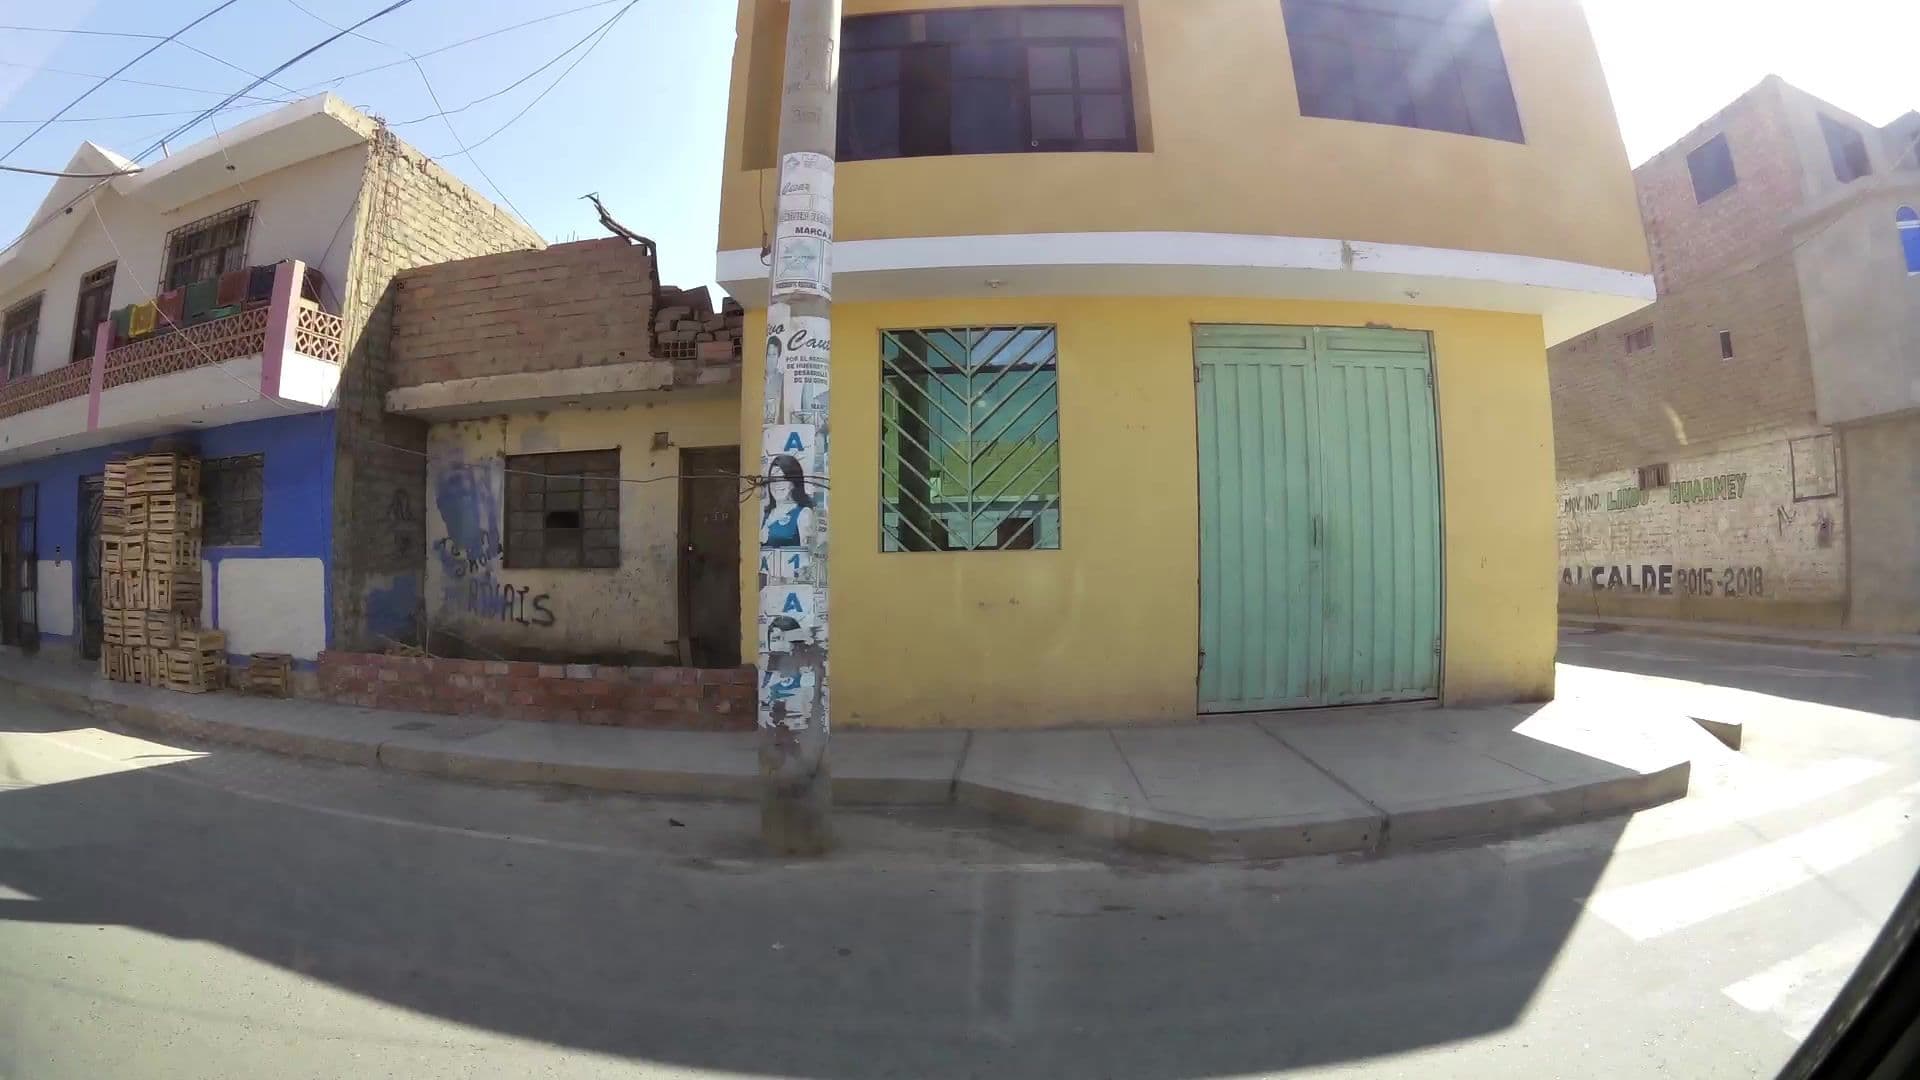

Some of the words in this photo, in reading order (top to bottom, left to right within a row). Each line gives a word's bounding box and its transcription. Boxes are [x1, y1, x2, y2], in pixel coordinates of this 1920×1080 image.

[784, 431, 805, 452] A
[1669, 472, 1748, 505] HUARMEY
[1562, 564, 1673, 595] ALCALDE
[782, 592, 804, 613] A
